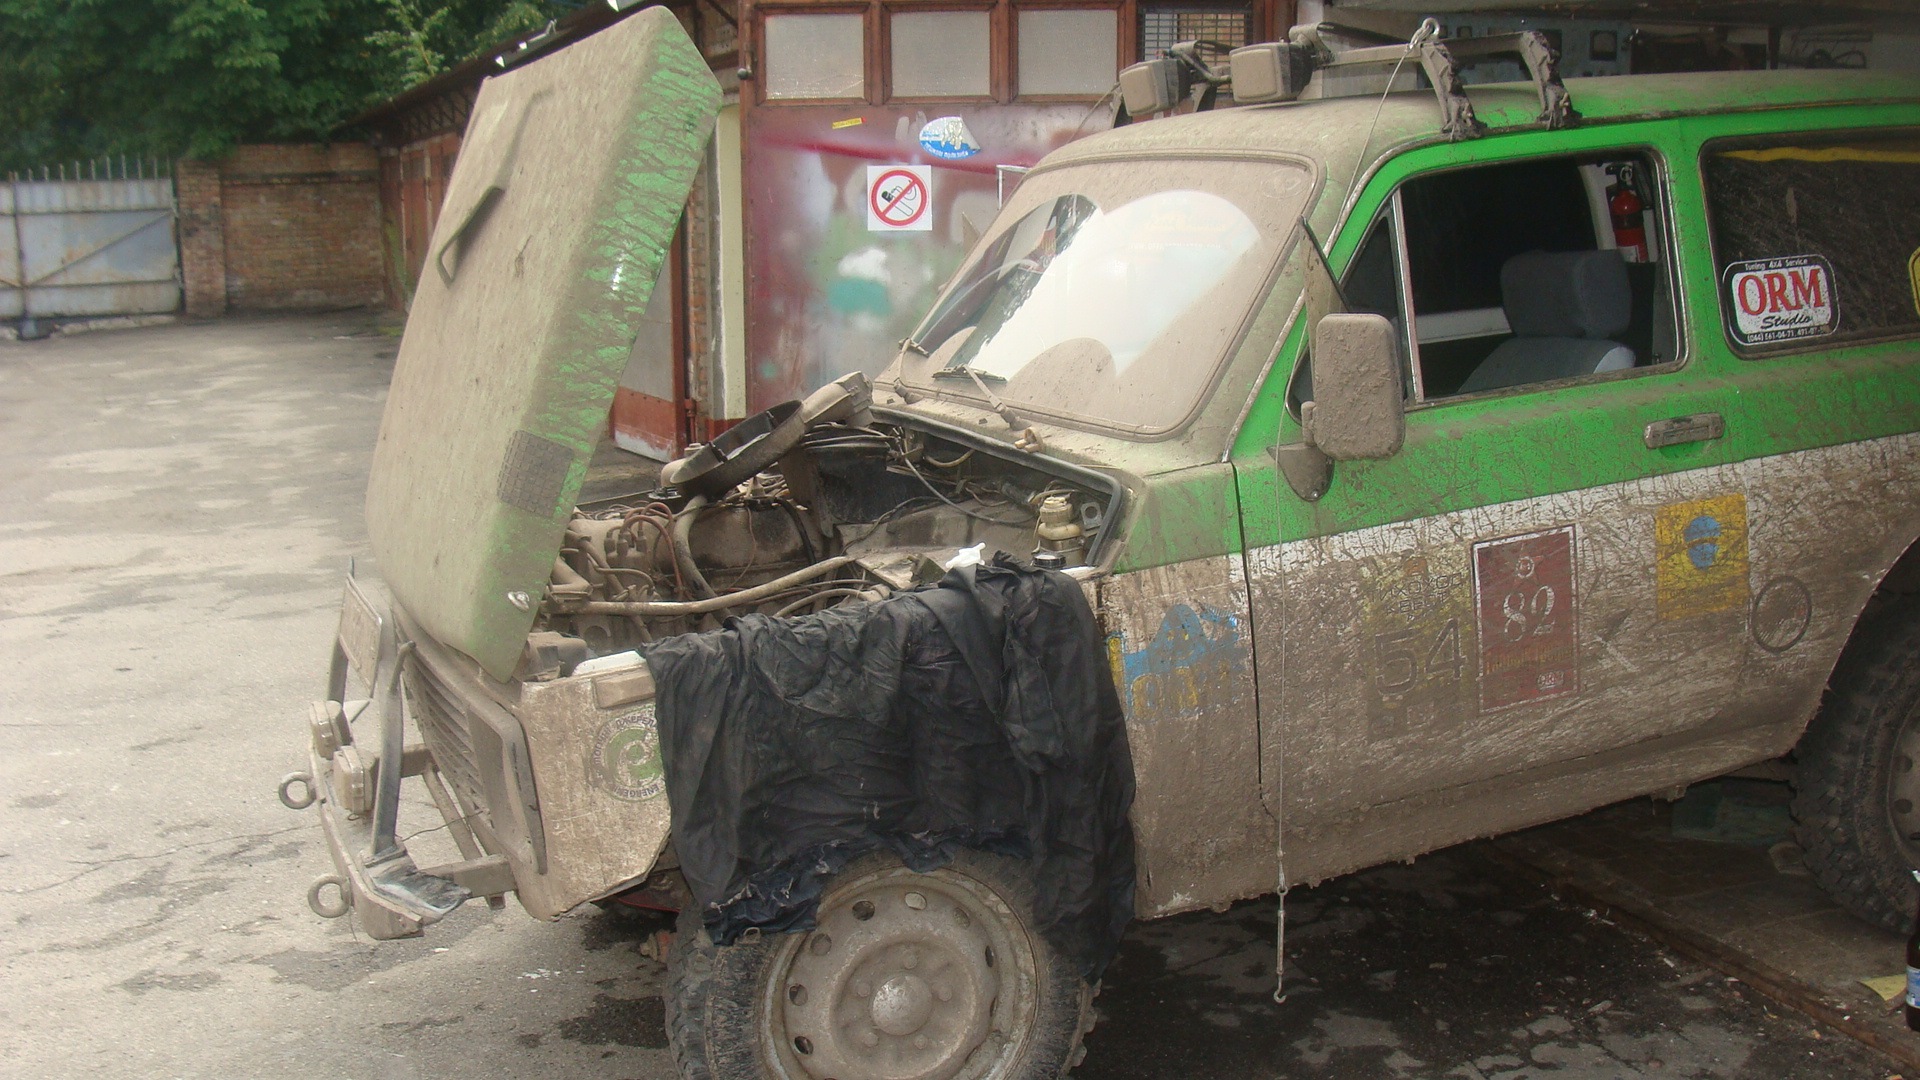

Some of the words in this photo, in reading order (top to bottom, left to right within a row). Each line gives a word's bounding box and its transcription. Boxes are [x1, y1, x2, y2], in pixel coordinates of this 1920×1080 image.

[1785, 257, 1808, 267] Service
[1738, 269, 1825, 316] ORM
[1760, 313, 1813, 329] Studio
[1503, 585, 1556, 642] 82
[1374, 618, 1468, 697] 54
